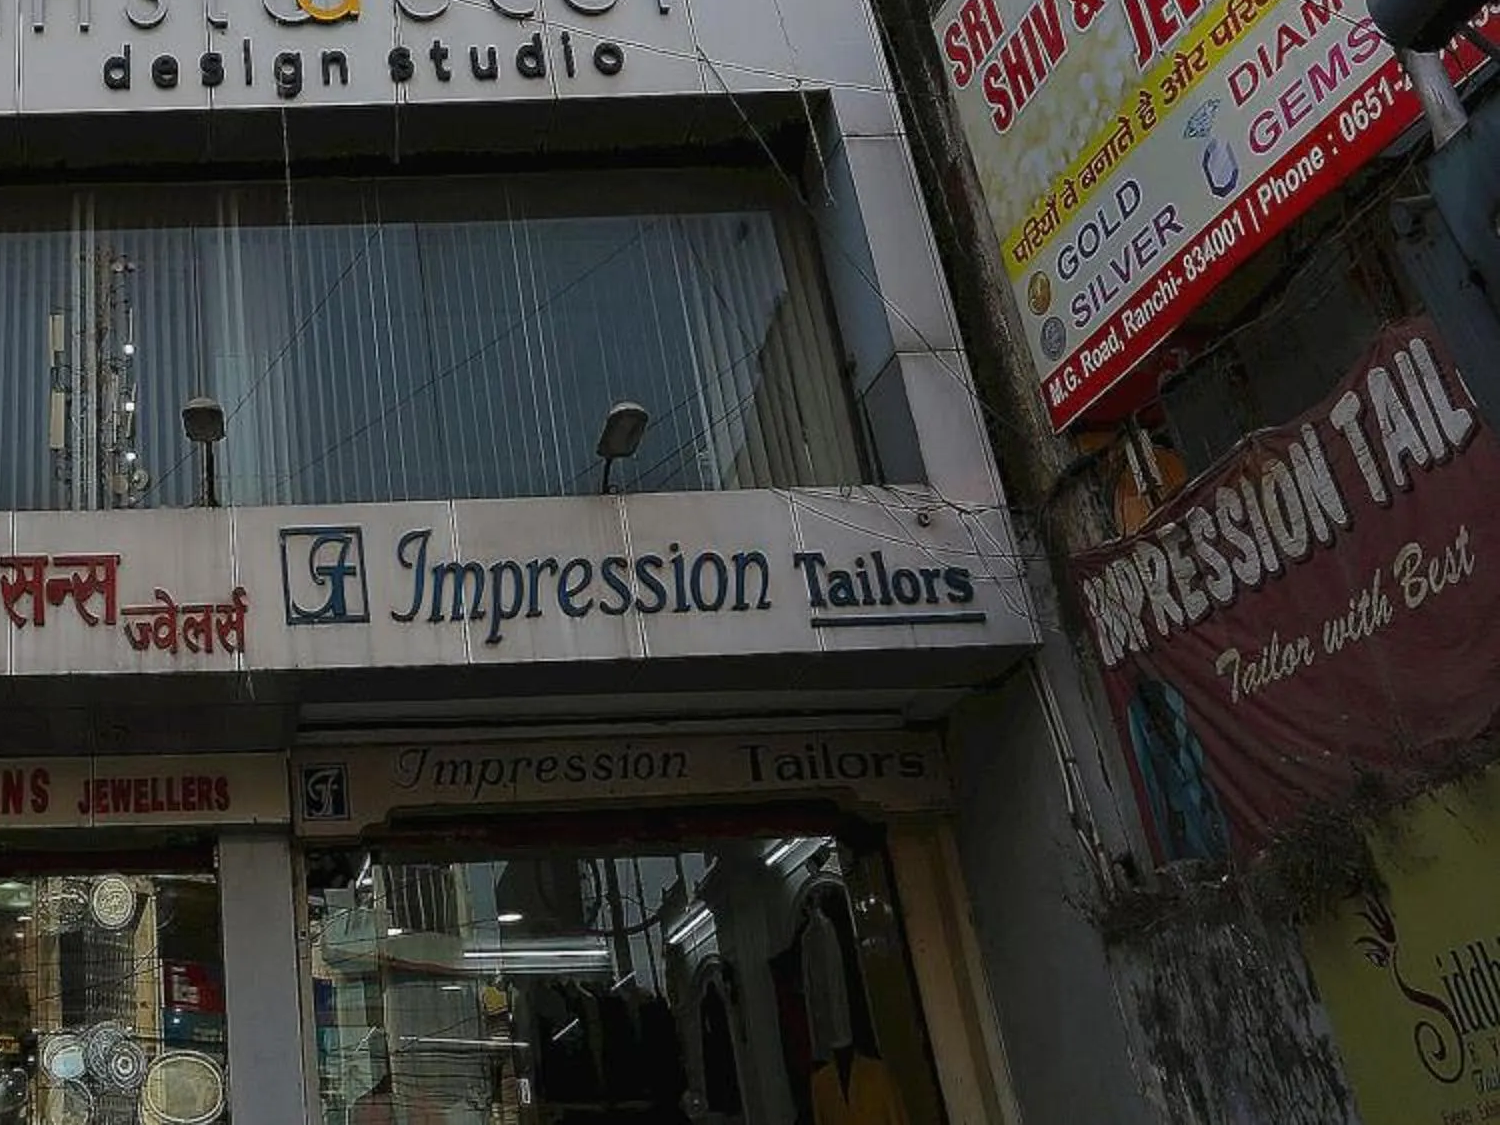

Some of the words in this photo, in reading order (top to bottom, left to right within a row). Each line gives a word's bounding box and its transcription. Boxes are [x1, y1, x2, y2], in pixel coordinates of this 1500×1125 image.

[103, 42, 350, 98] design
[387, 30, 625, 83] studio
[1159, 41, 1210, 105] और
[1070, 204, 1184, 328] SILVER
[1247, 17, 1382, 156] GEMS
[1049, 366, 1083, 407] M.G.
[1080, 325, 1125, 377] Road,
[1121, 271, 1182, 337] Ranchi-
[1183, 209, 1245, 283] 834001
[1256, 146, 1326, 217] Phone
[1056, 179, 1142, 280] GOLD
[1083, 424, 1348, 667] IMPRESSION
[1331, 336, 1475, 504] TAIL
[0, 554, 121, 629] सन्स
[390, 528, 772, 644] Impression
[793, 550, 975, 609] Tailors
[1216, 628, 1315, 705] Tailor
[1322, 567, 1393, 663] with
[1393, 525, 1475, 613] Best
[77, 775, 231, 815] JEWELLERS
[395, 745, 687, 798] Impression
[740, 744, 926, 784] Tailors
